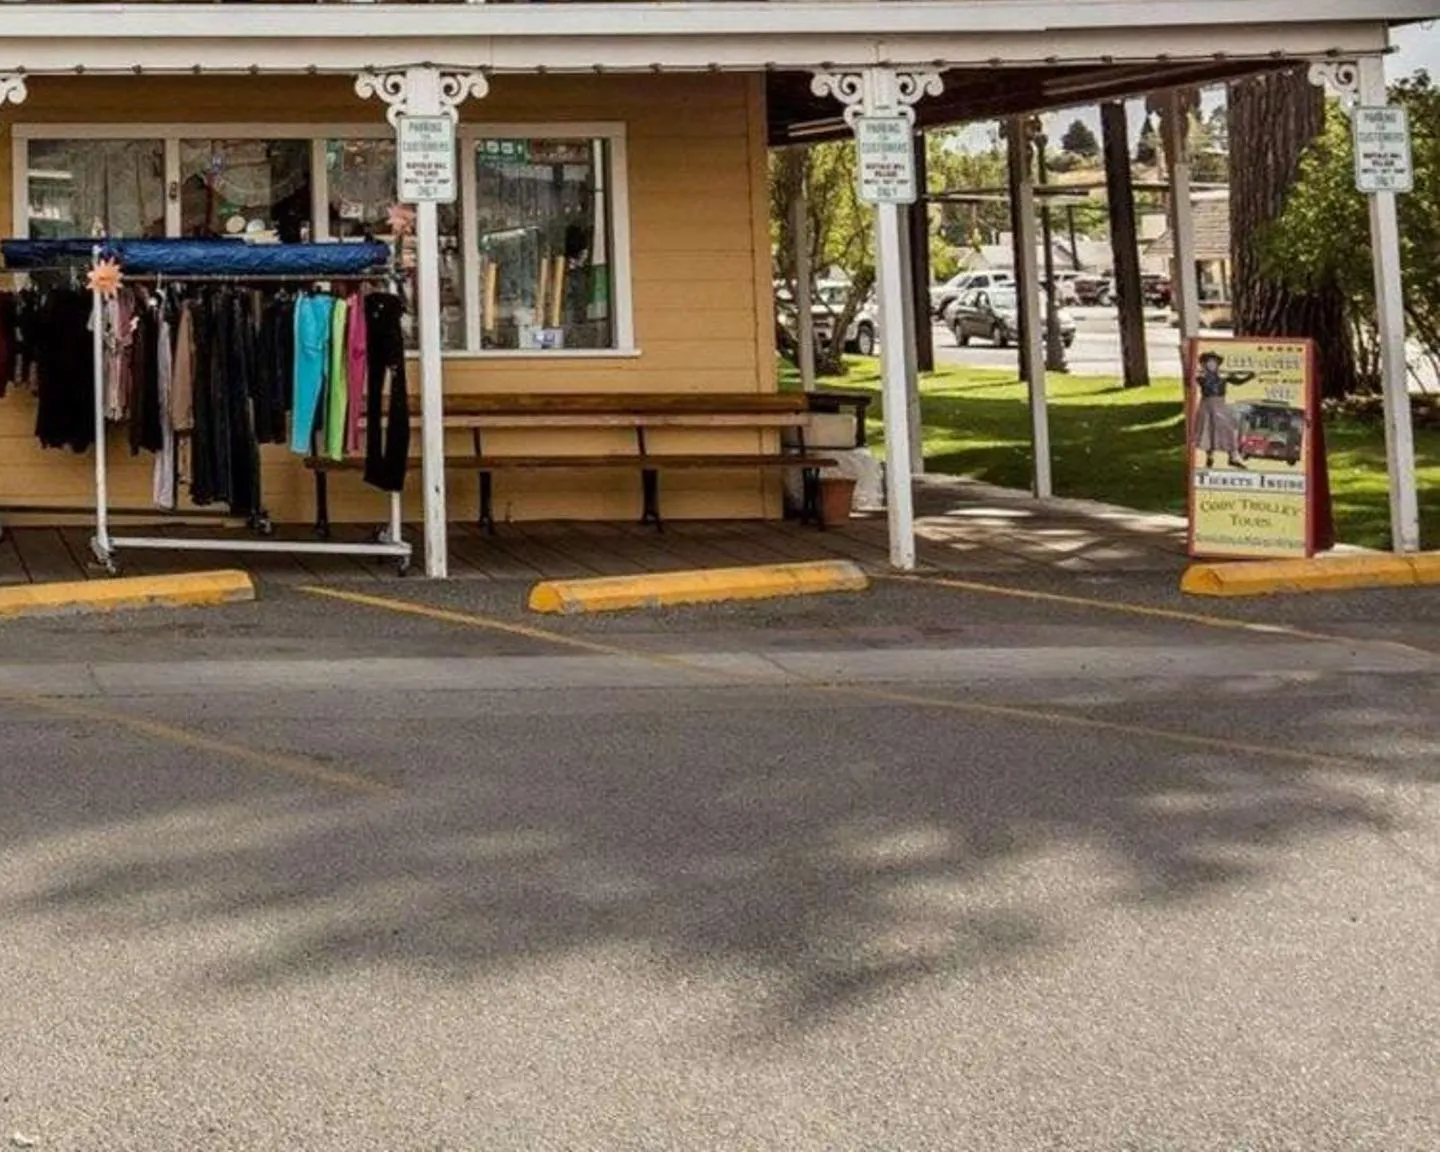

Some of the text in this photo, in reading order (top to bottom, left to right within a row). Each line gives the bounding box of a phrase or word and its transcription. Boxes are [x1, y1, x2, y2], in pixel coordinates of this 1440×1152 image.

[1363, 112, 1397, 123] PARKING
[408, 121, 443, 132] PARKING
[866, 123, 900, 133] PARKING
